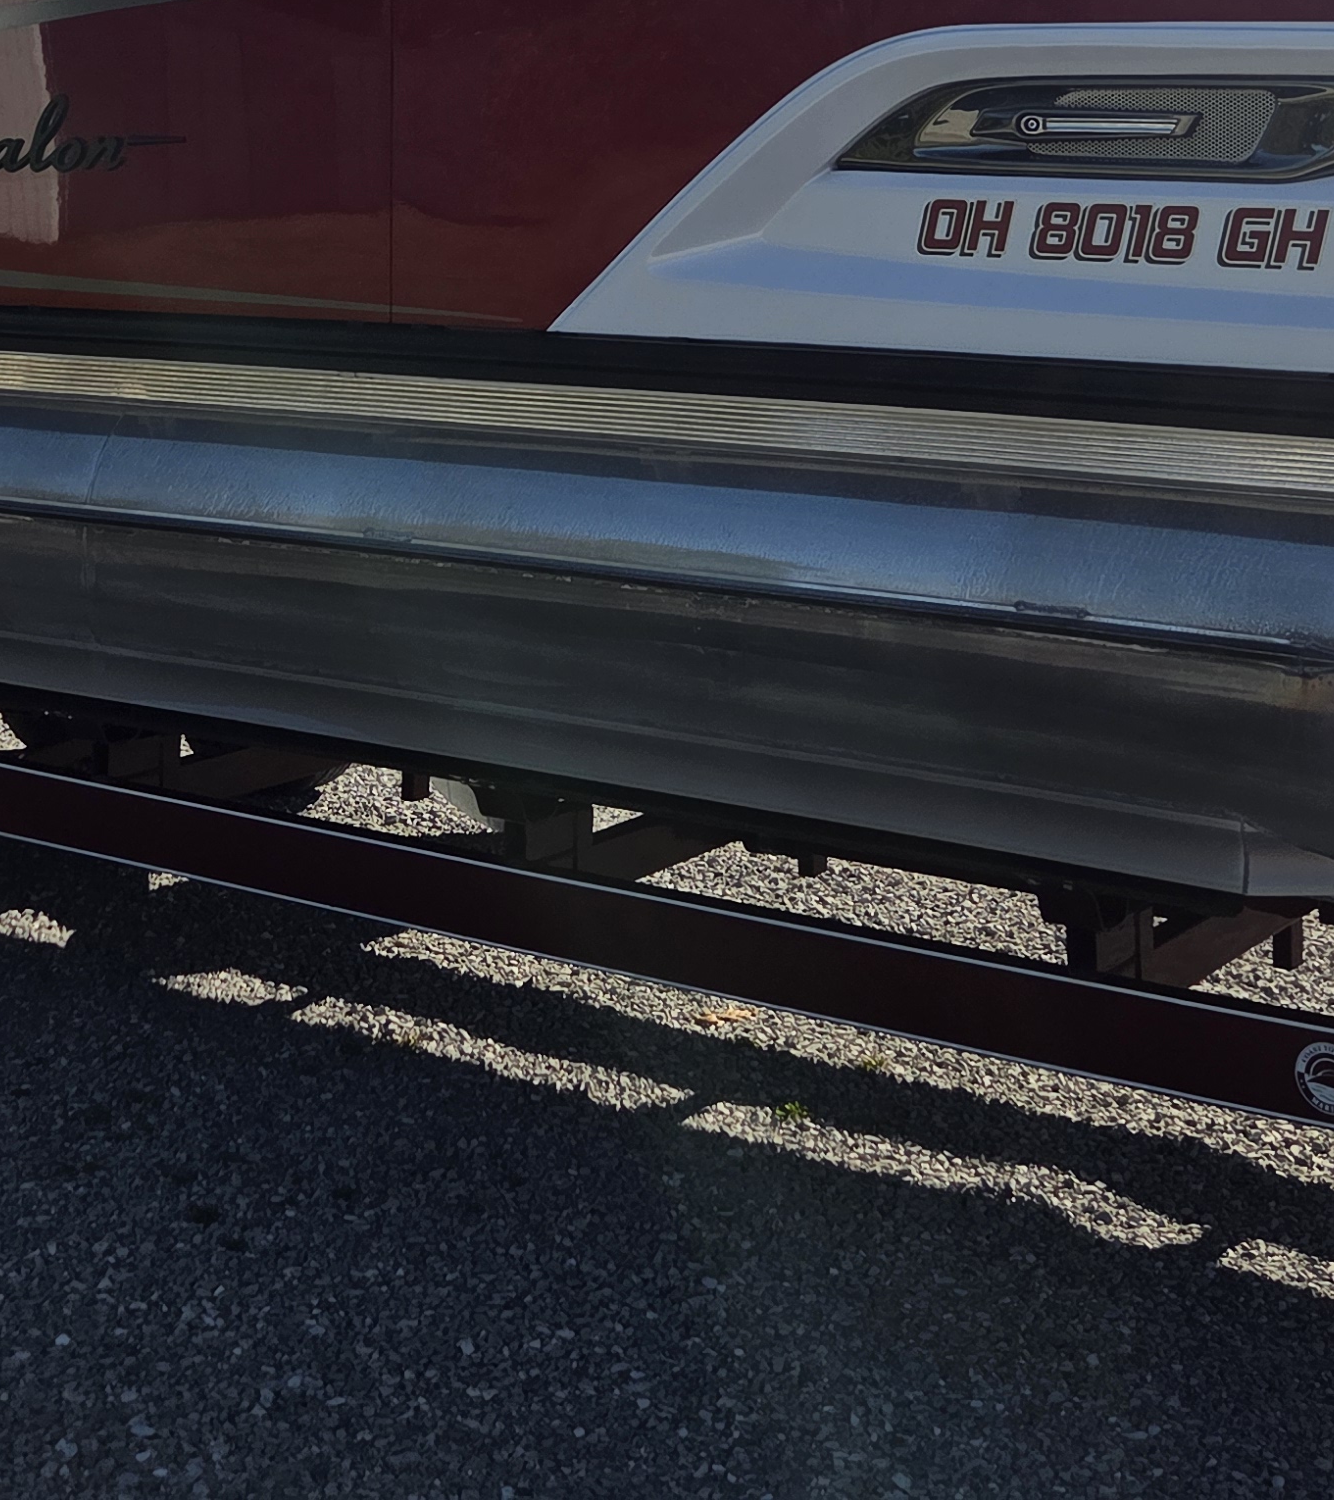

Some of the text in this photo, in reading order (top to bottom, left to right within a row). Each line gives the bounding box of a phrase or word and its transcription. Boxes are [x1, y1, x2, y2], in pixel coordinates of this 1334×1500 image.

[916, 199, 1330, 271] OH 8018 GH
